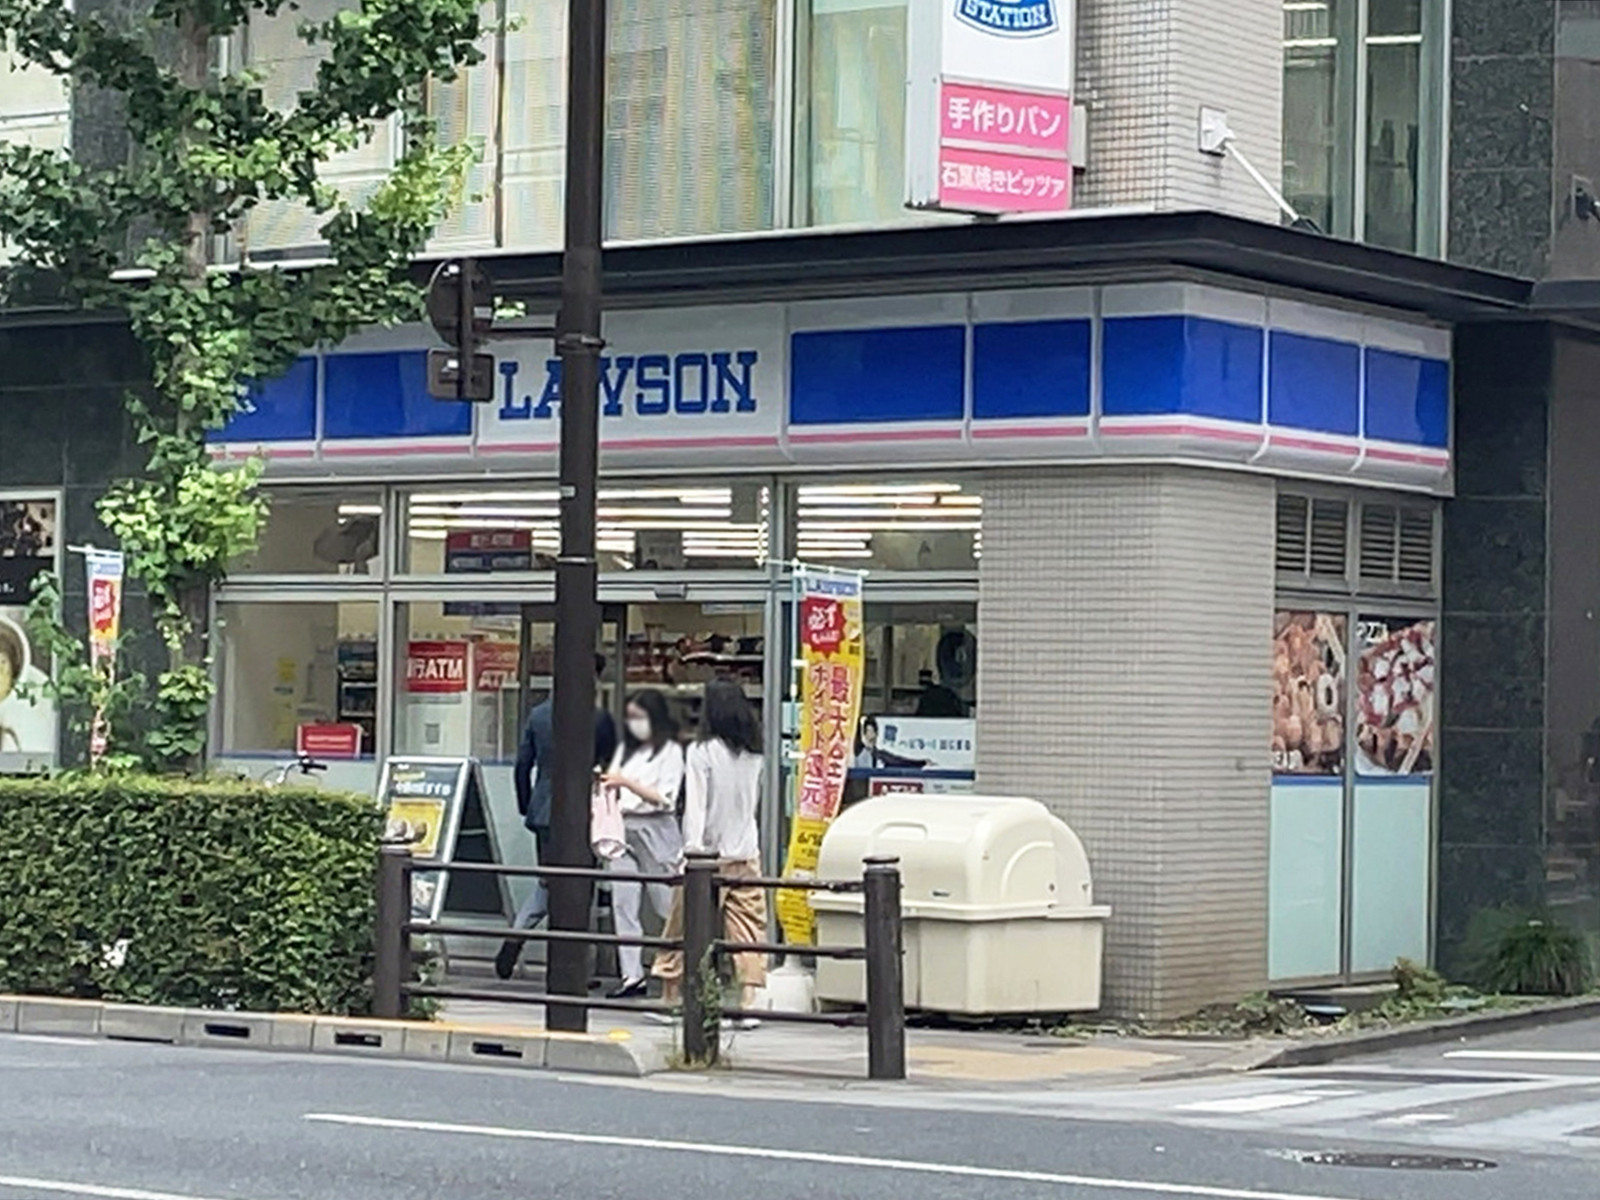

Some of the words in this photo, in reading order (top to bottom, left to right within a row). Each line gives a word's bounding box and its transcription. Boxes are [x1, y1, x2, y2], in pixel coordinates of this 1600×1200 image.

[964, 0, 1048, 28] STATION
[948, 97, 1061, 137] 手作りパン
